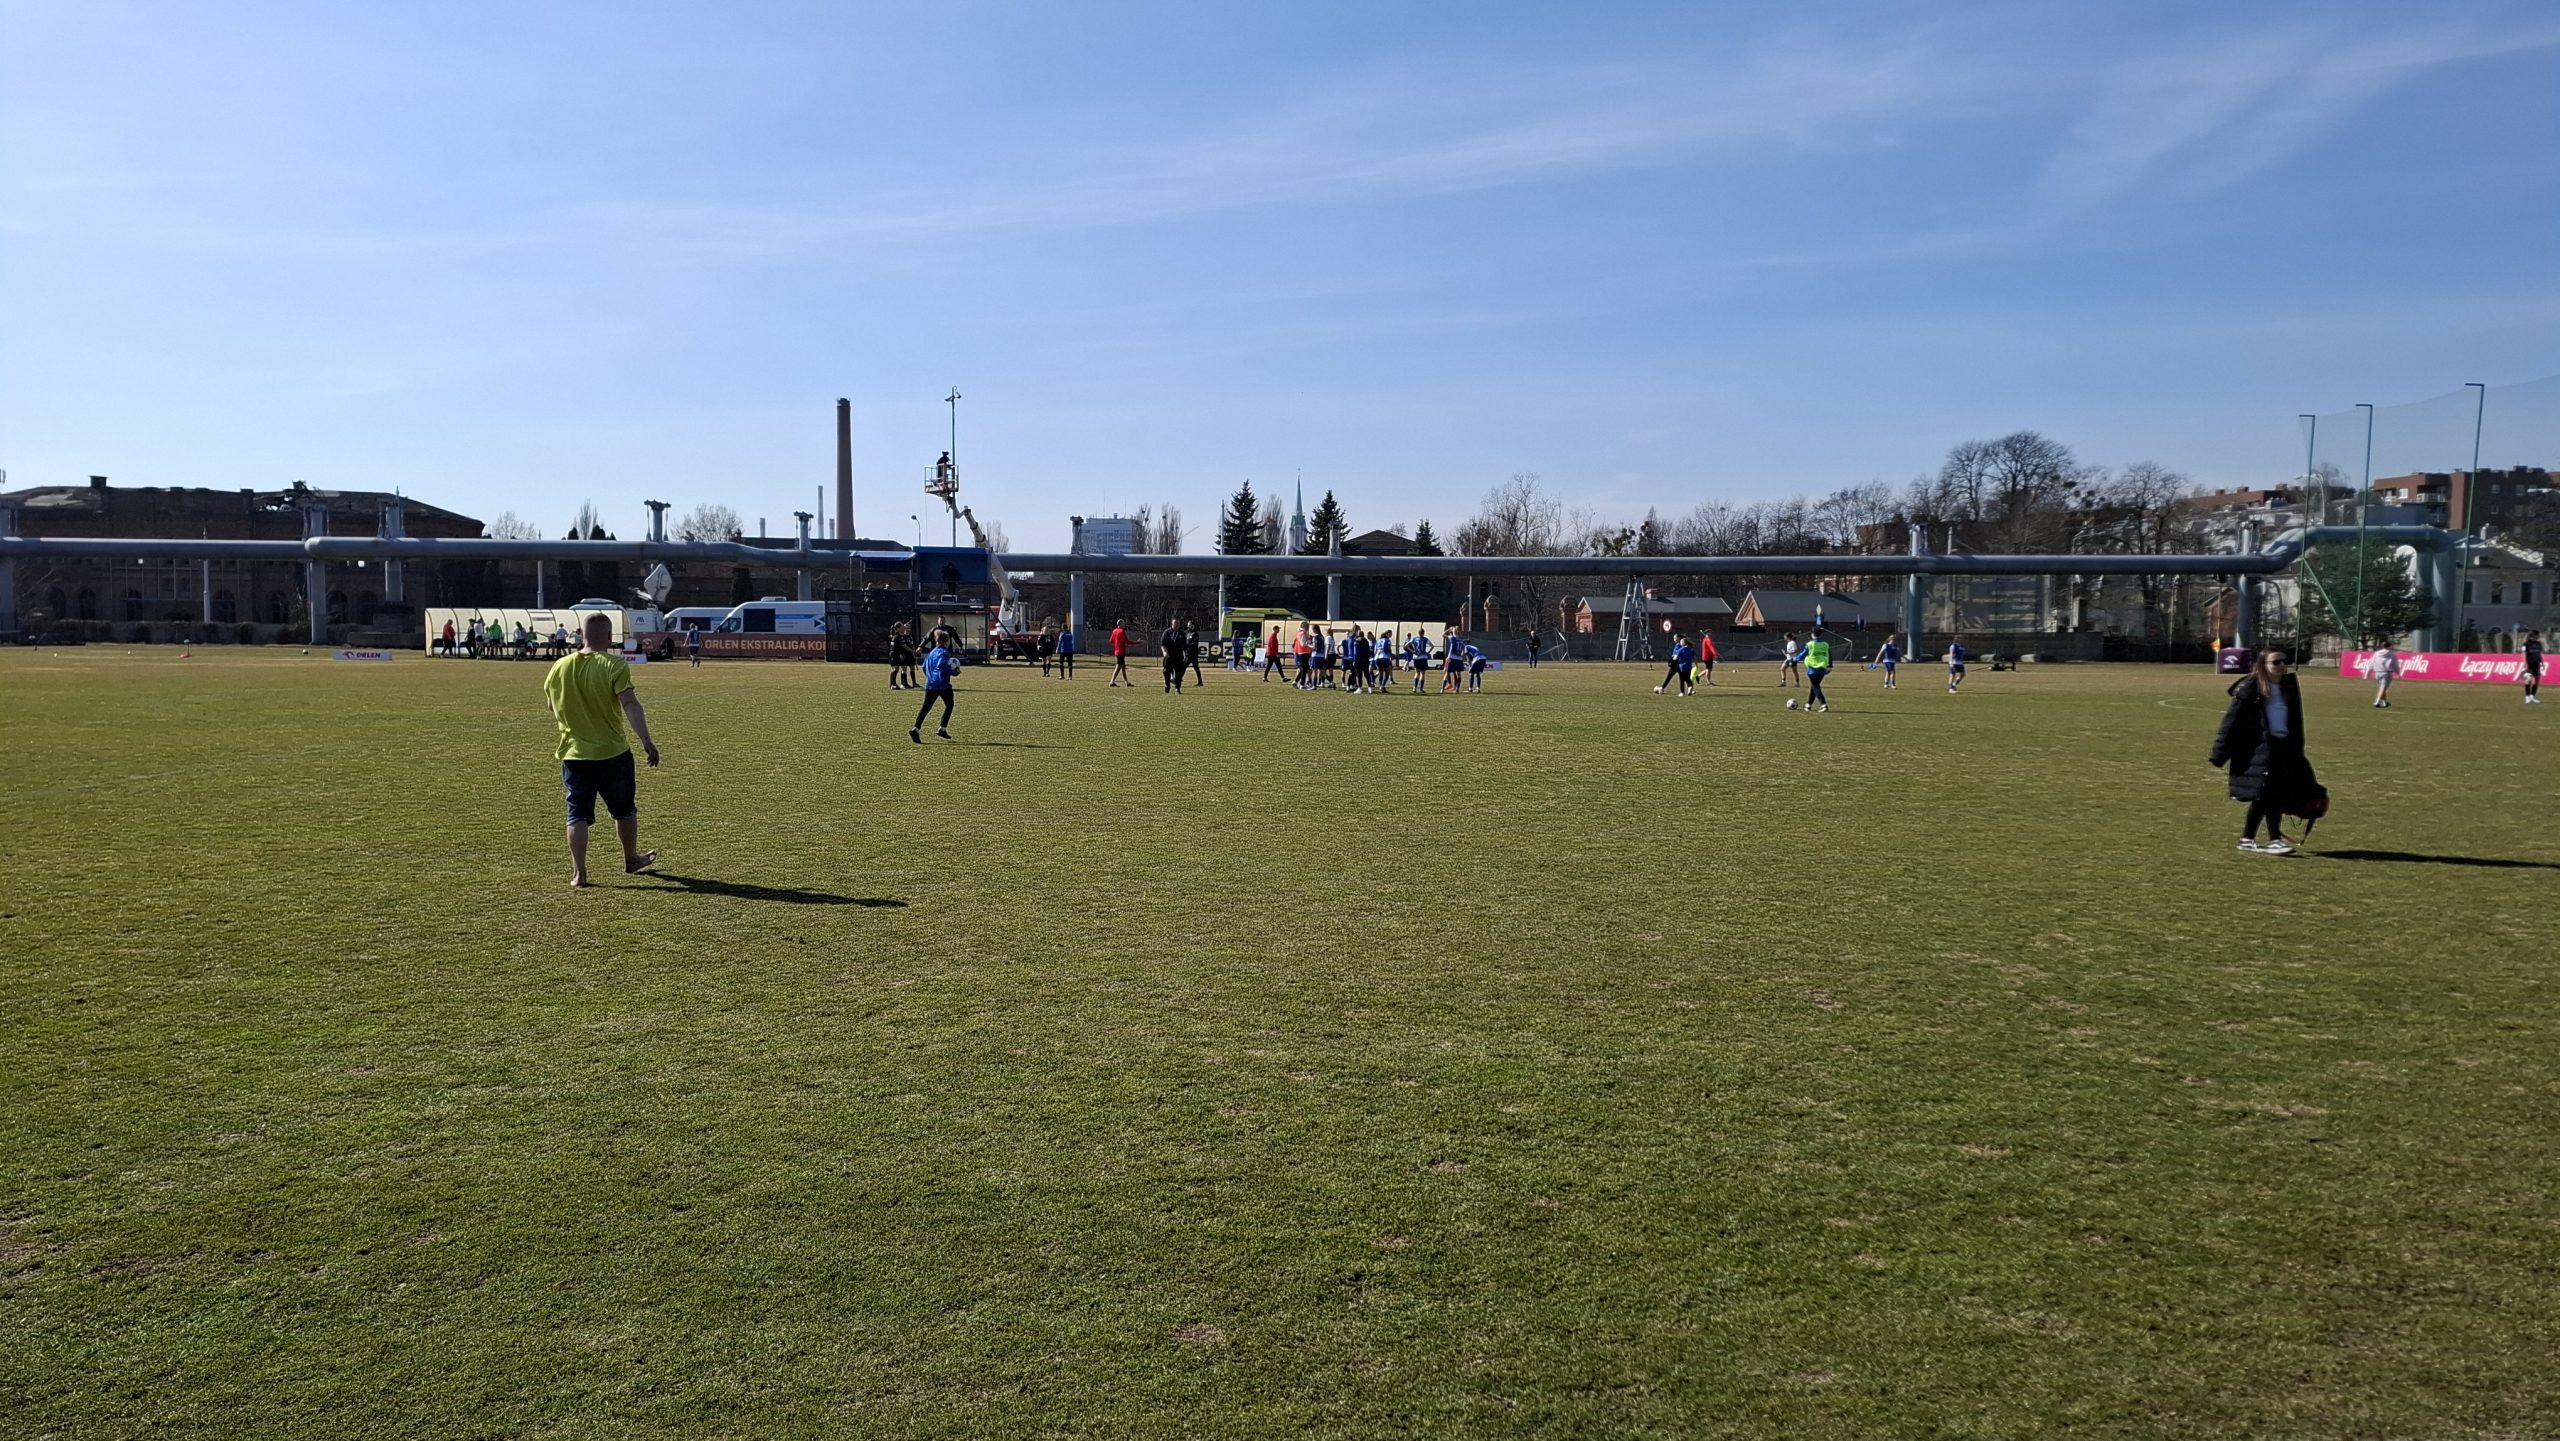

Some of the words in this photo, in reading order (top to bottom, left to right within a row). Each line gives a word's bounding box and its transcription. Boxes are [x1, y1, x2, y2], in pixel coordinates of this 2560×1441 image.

[704, 640, 739, 649] ORLEN
[741, 640, 806, 650] EKSTRALIGA
[356, 651, 381, 659] ORLEN
